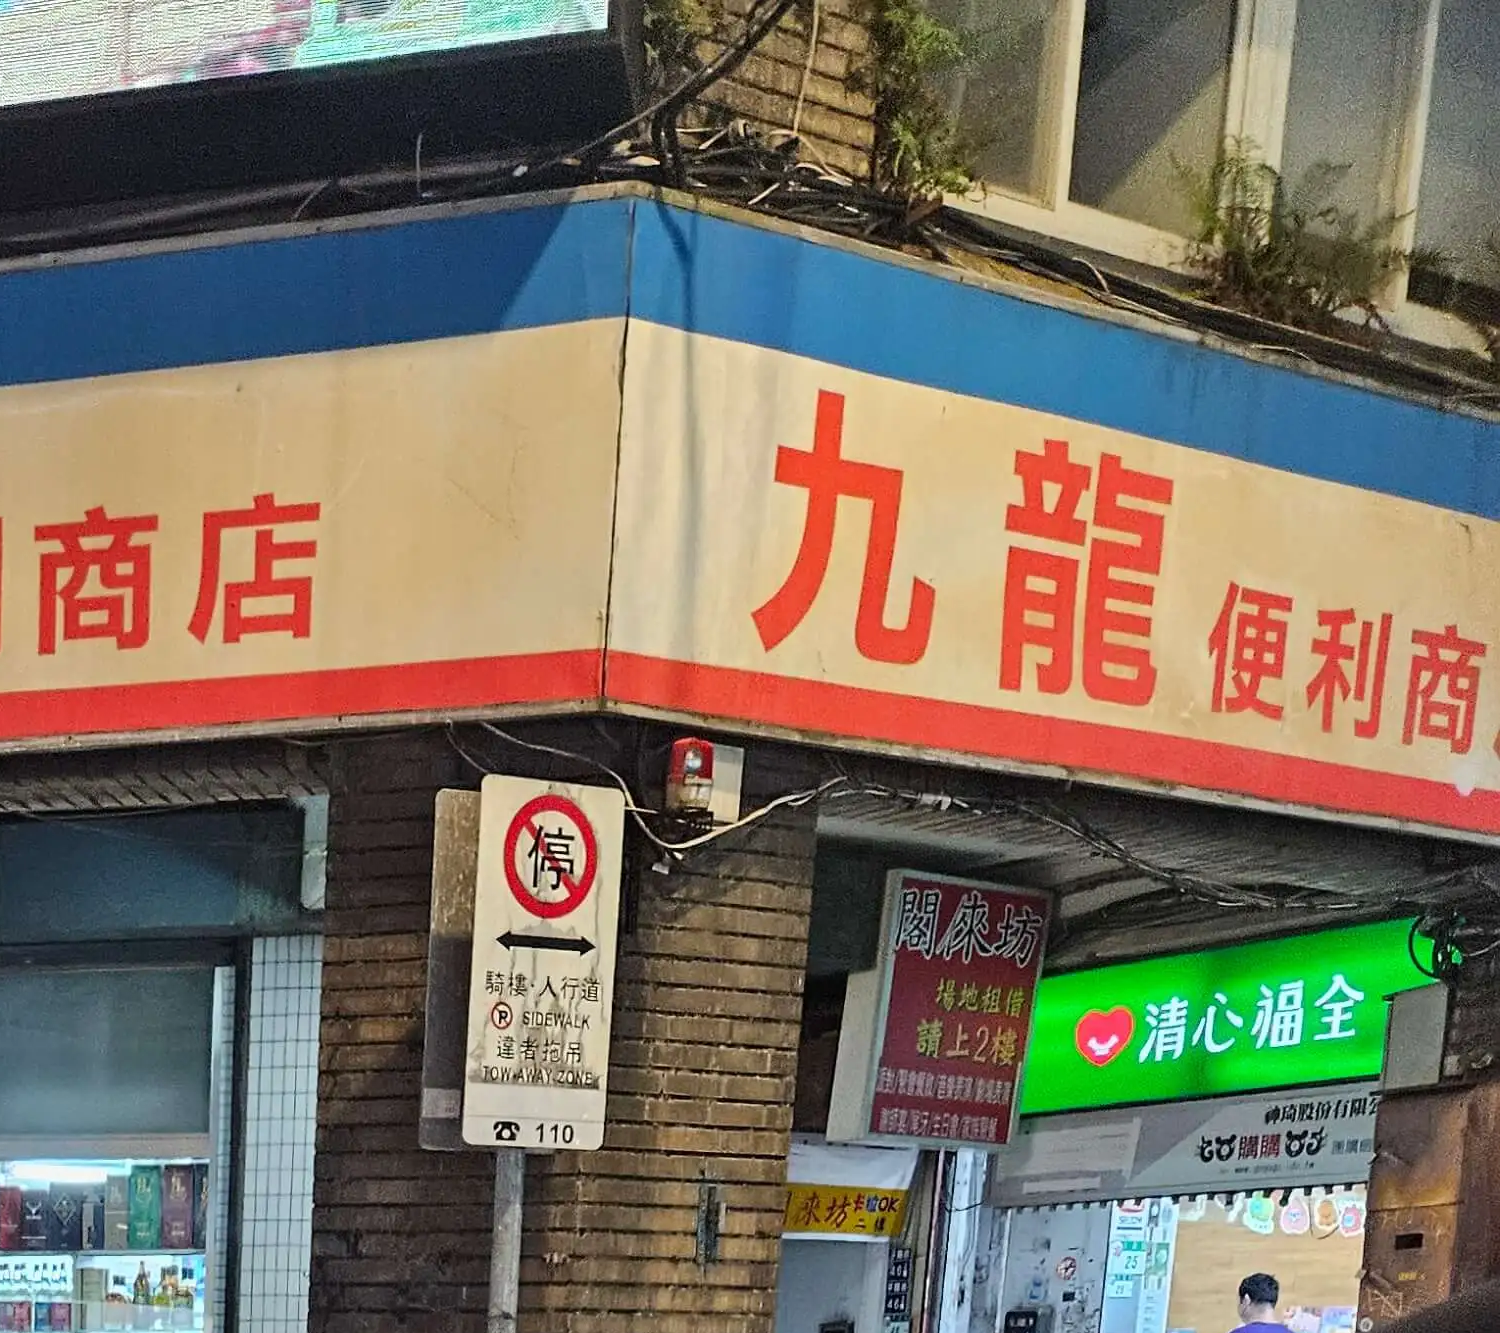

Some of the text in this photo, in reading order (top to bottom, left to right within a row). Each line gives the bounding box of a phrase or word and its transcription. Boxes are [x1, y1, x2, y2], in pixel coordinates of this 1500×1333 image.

[750, 388, 1500, 757] 九龍便利商
[527, 824, 575, 890] 停
[936, 977, 1025, 1017] 場地租借
[1138, 973, 1365, 1064] 清心福全
[522, 1010, 591, 1030] SIDEWALK
[497, 1035, 582, 1065] 違者拖吊
[916, 1019, 1018, 1067] 請上2樓
[535, 1122, 575, 1144] 110
